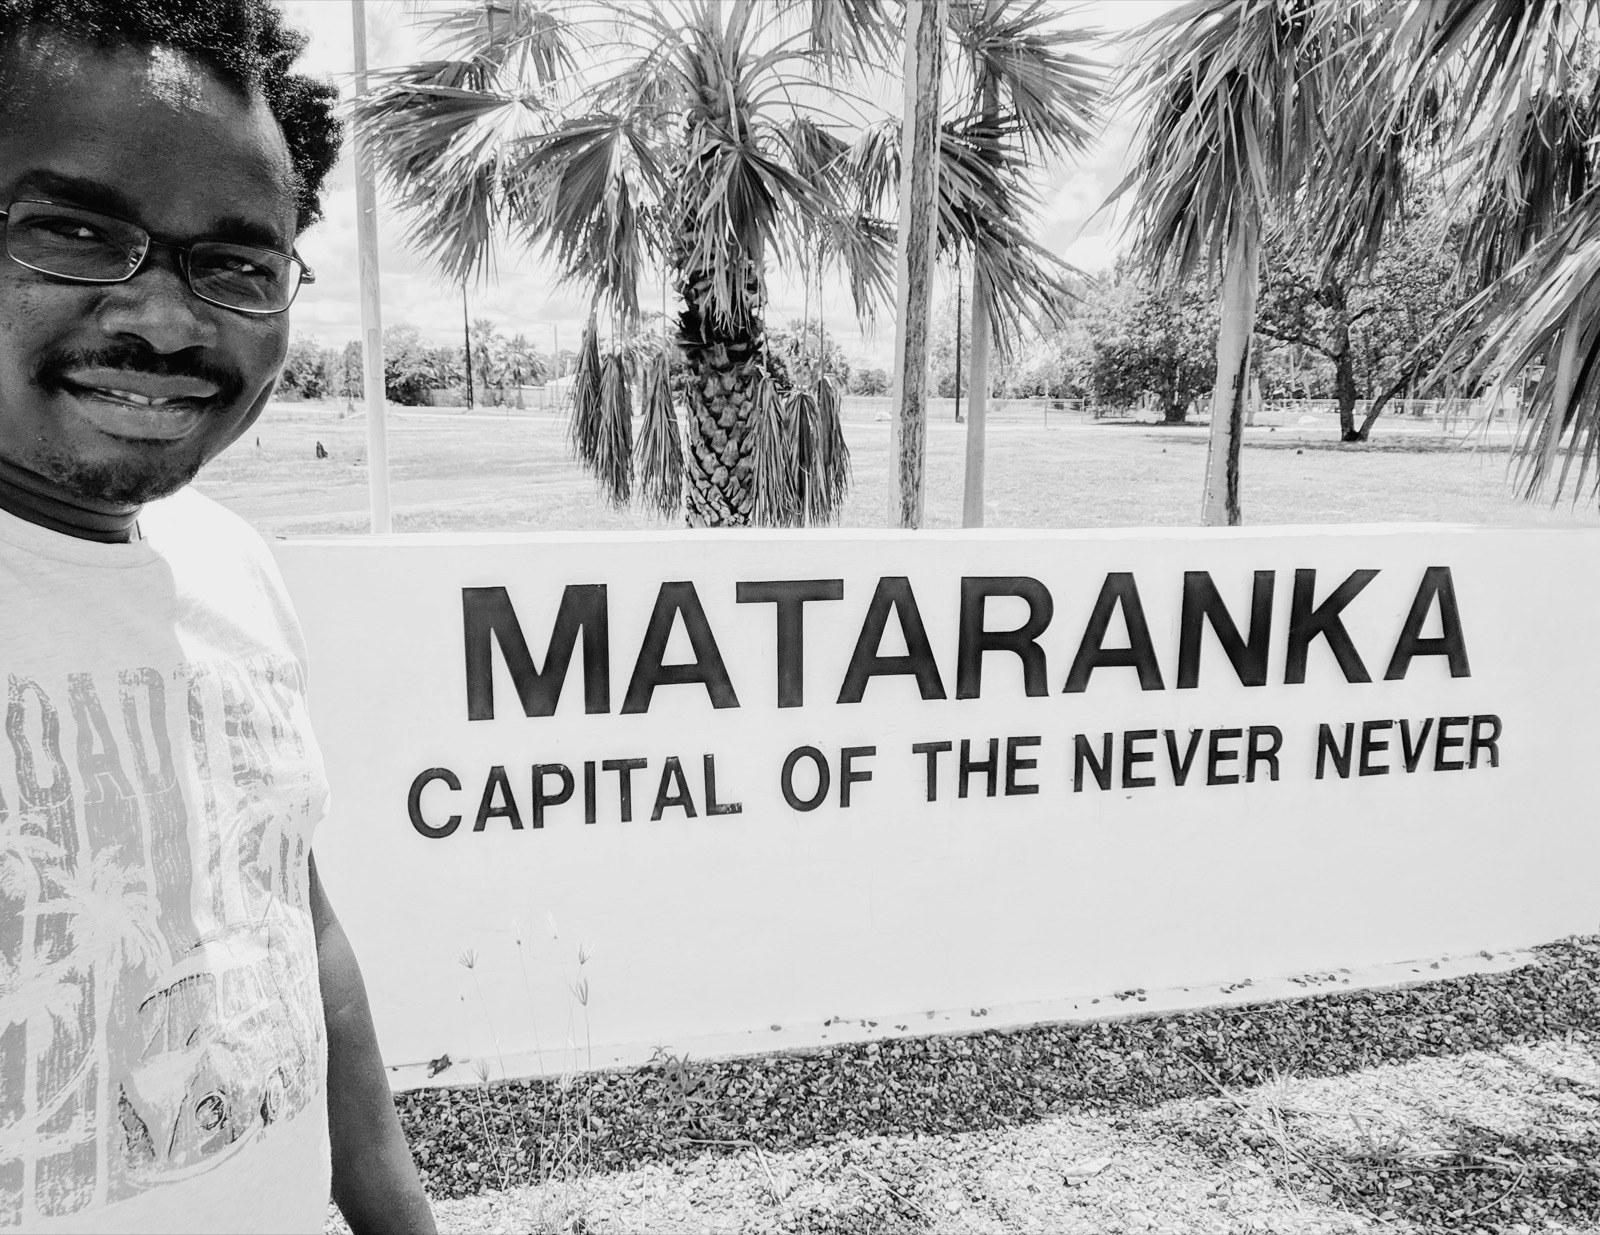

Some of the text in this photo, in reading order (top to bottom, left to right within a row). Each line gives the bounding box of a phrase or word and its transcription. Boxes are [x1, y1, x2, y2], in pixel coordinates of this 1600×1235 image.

[461, 566, 1471, 722] MATARANKA
[407, 714, 1502, 839] CAPITAL OF THE NEVER NEVER
